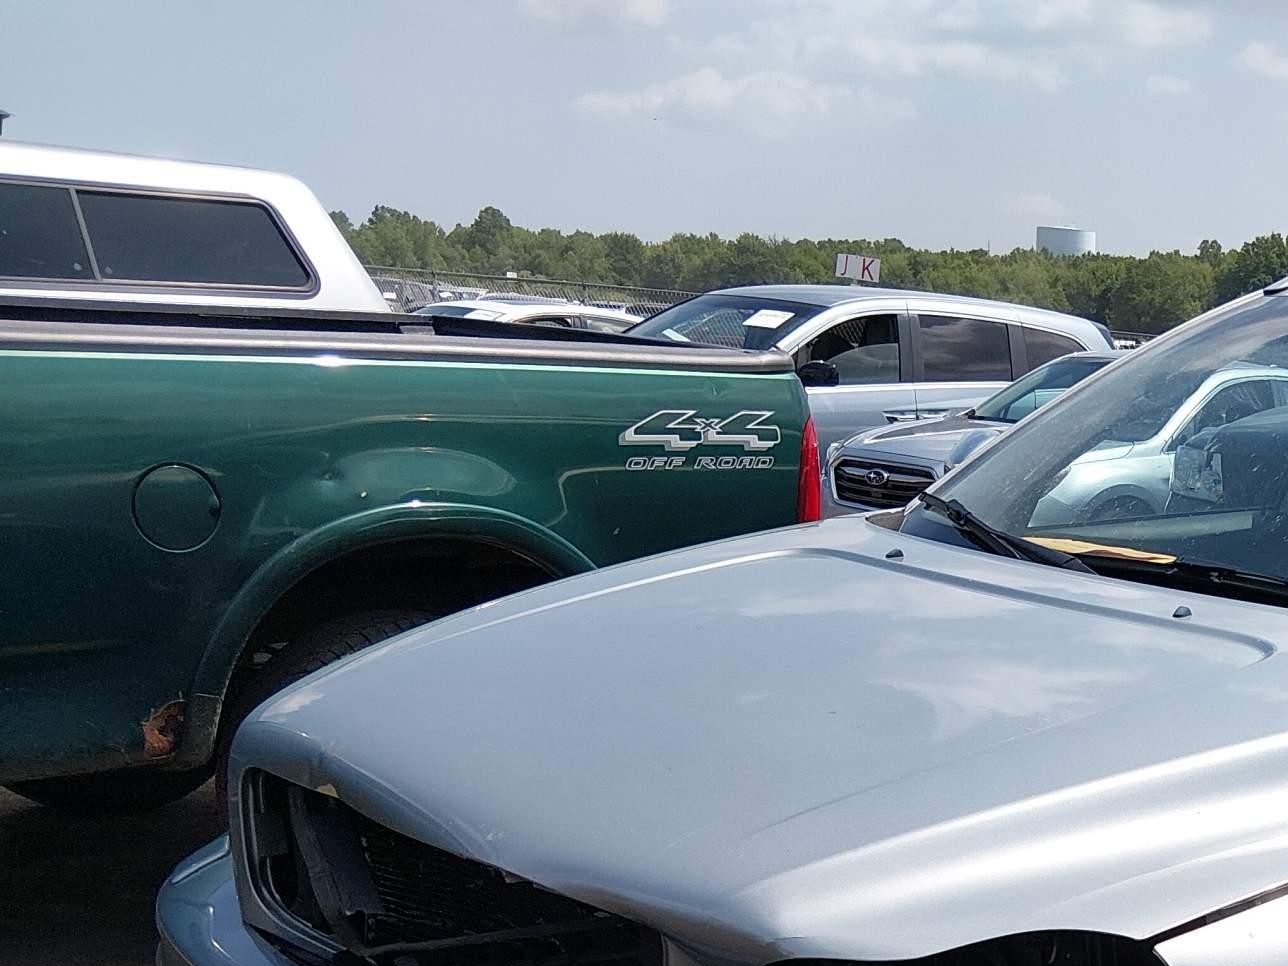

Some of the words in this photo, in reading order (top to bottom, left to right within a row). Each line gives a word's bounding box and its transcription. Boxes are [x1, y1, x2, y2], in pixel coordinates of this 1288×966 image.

[840, 255, 848, 276] J
[862, 258, 875, 281] K
[625, 456, 686, 471] OFF
[693, 456, 774, 469] ROAD
